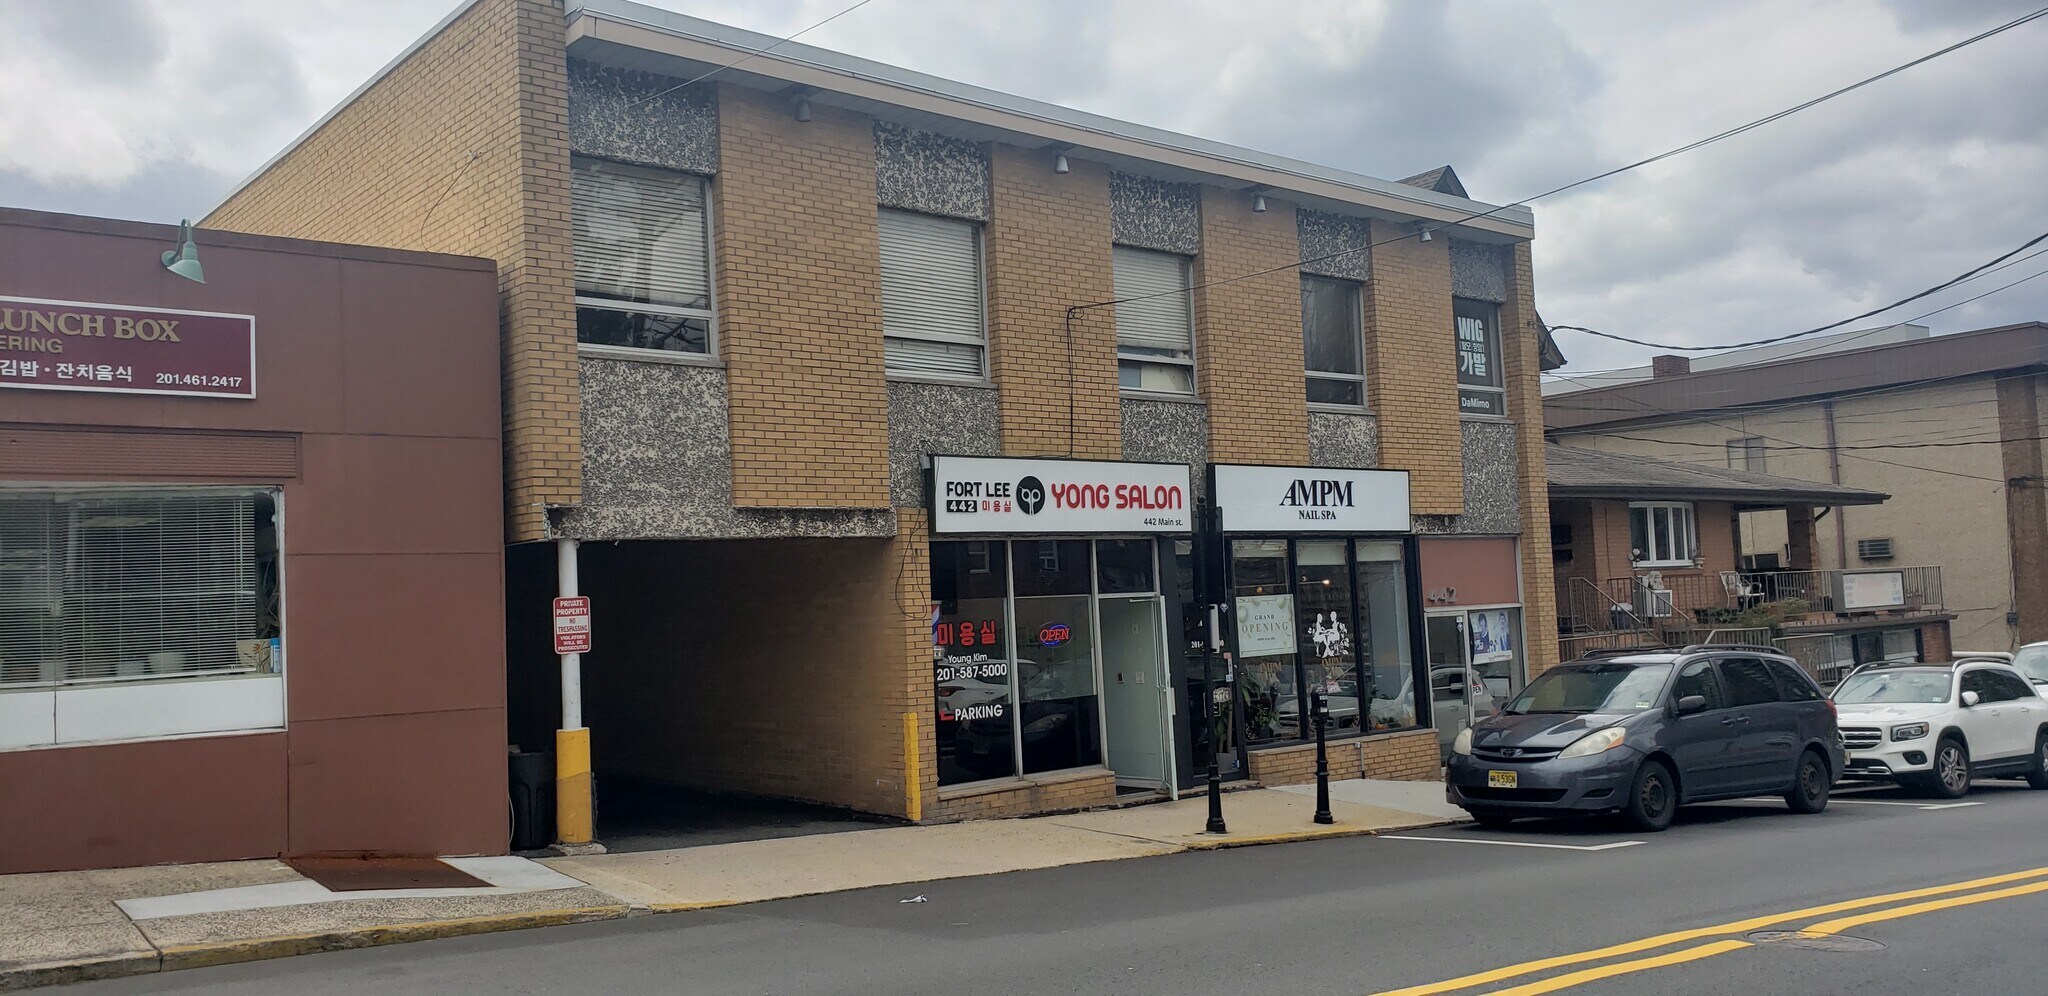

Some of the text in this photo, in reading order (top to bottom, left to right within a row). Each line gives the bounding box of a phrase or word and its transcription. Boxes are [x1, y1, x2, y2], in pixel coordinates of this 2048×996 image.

[113, 316, 181, 342] BOX
[1457, 316, 1484, 342] WIG
[0, 359, 133, 382] 김밥 잔치음식
[1460, 351, 1487, 377] 가발
[156, 372, 242, 388] 201.461.2417
[1461, 397, 1490, 409] DaMimo
[946, 481, 1011, 498] FORT LEE
[1051, 483, 1182, 509] YONG SALON
[1278, 479, 1355, 507] AMPM
[949, 500, 976, 512] 442
[982, 500, 1012, 512] 미용실
[1143, 517, 1157, 526] 442
[1158, 517, 1174, 526] Main
[1298, 510, 1337, 520] NAIL SPA
[937, 620, 997, 646] 미용실
[1039, 627, 1070, 642] OPEN
[1241, 621, 1288, 634] OPENING
[948, 653, 988, 664] Young Kim
[936, 663, 1007, 681] 201-587-5000
[955, 704, 1003, 721] PARKING
